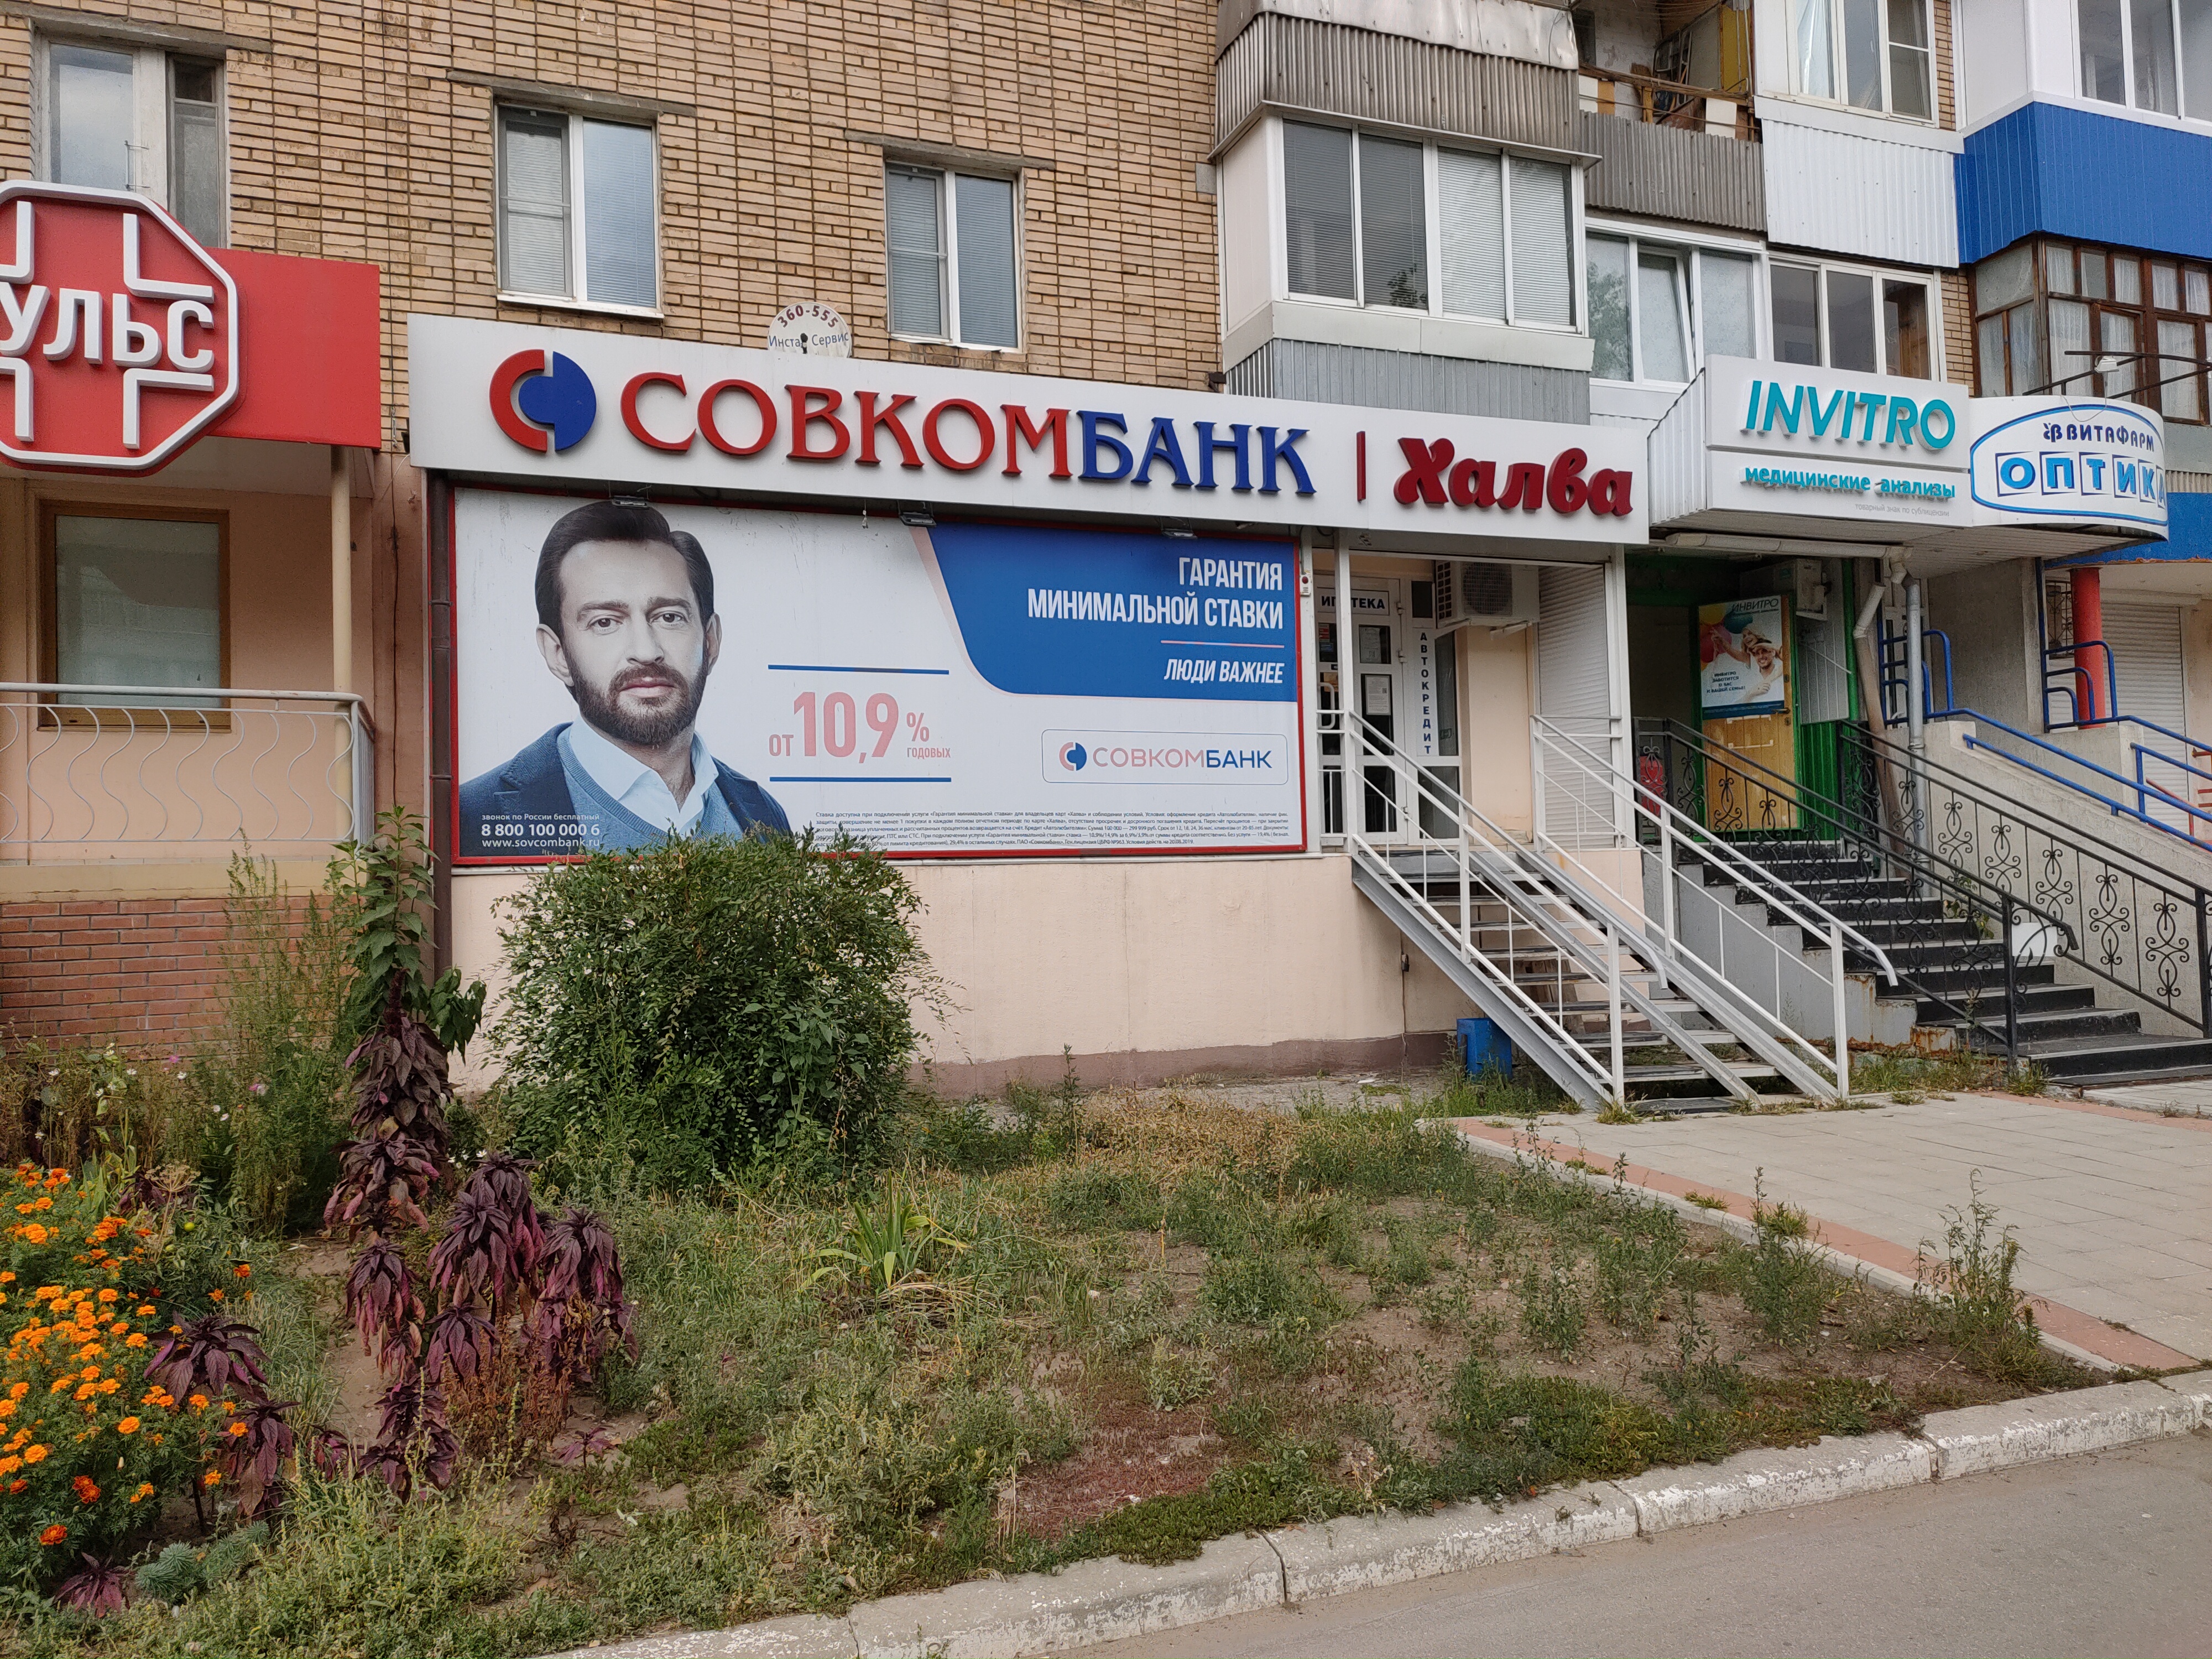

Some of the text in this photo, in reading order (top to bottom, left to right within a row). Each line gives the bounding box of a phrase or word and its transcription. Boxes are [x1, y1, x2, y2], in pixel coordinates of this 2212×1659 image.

[778, 305, 839, 327] 360-555
[769, 332, 849, 348] Инста Сервис
[1741, 380, 1955, 449] INVITRO
[620, 372, 1633, 517] СОВКОМБАНК Халва
[2067, 424, 2154, 452] ВИТАФАРМ
[1743, 467, 1955, 498] медицинские анализы
[2000, 457, 2165, 503] ОПТИКА
[1855, 503, 1885, 512] товарный
[1912, 507, 1949, 516] сублицензии
[1179, 557, 1282, 591] ГАРАНТИЯ
[1027, 588, 1283, 629] МИНИМАЛЬНОЙ СТАВКИ
[1733, 598, 1779, 612] ИНВИТРО
[1164, 659, 1285, 684] ЛЮДИ ВАЖНЕЕ
[1420, 632, 1431, 754] АВТОКРЕДИТ
[1093, 747, 1272, 769] СОВКОМБАНК
[481, 823, 600, 836] 8 800 100 000 6
[482, 837, 600, 847] www.sovcombank.ru
